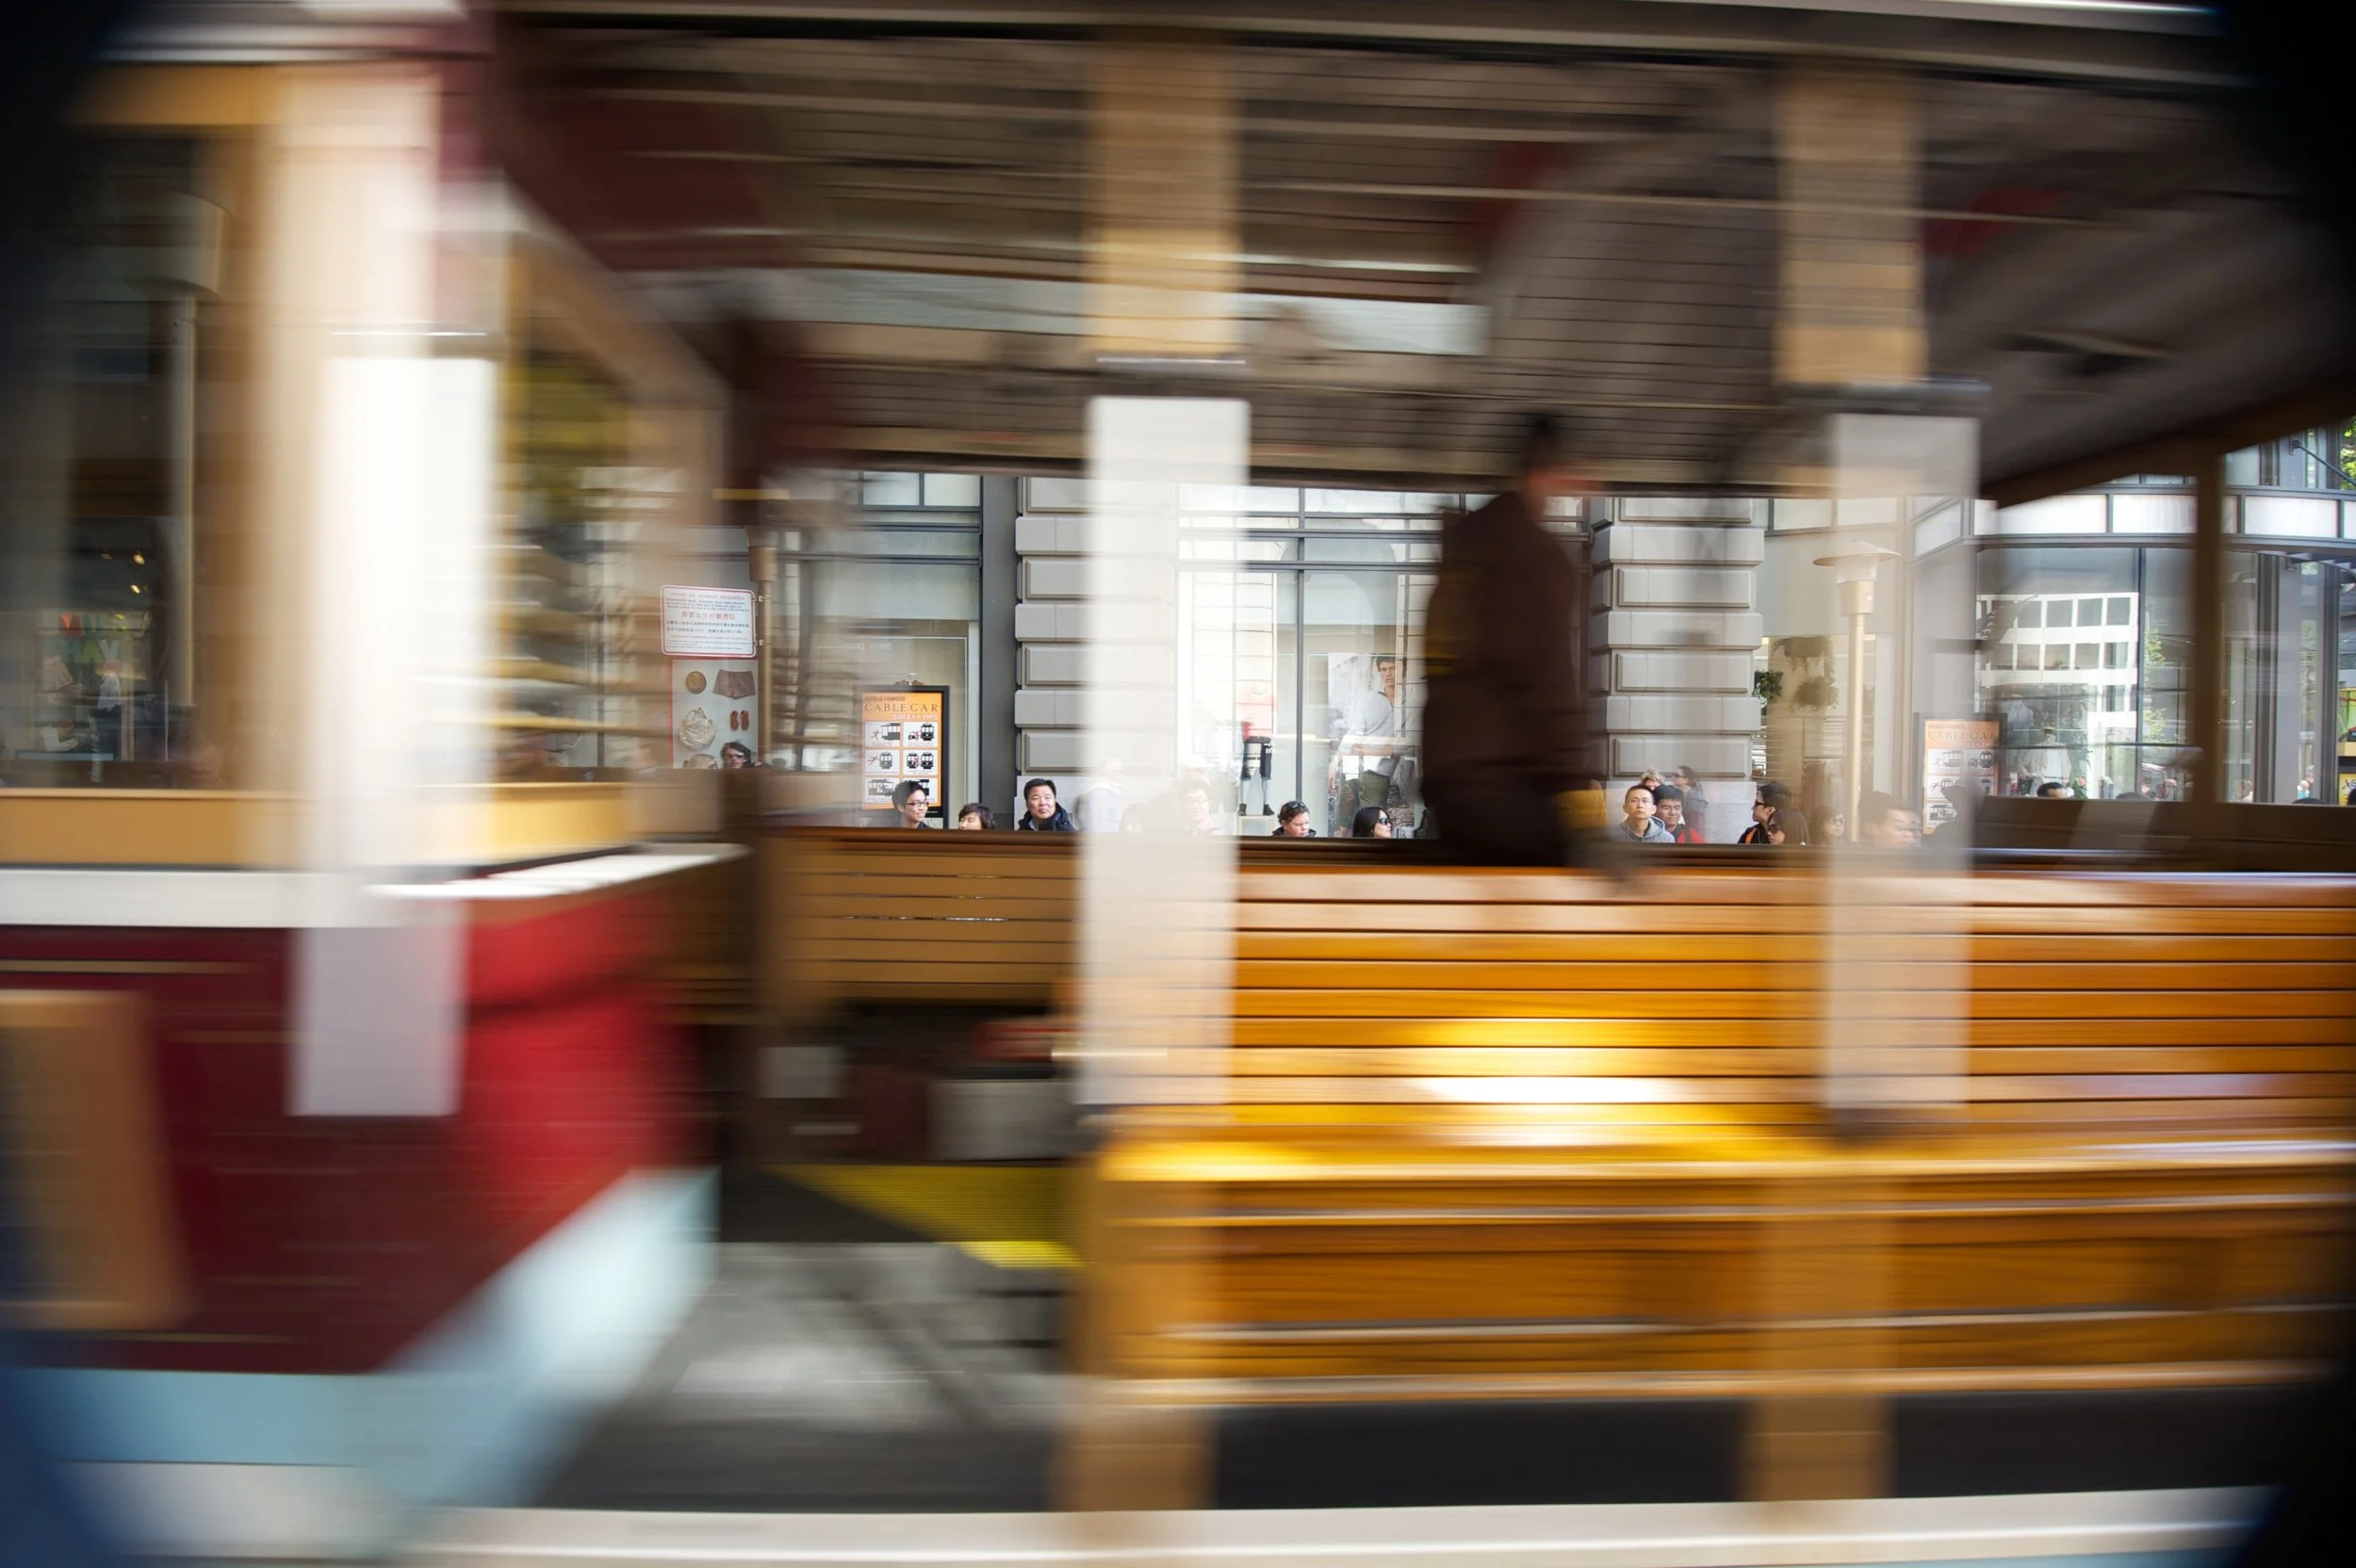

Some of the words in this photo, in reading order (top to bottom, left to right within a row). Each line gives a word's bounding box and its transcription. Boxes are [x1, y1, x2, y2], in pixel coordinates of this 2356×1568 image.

[864, 703, 907, 712] CABLE
[909, 703, 939, 712] CAR
[1927, 731, 1966, 740] CABLE
